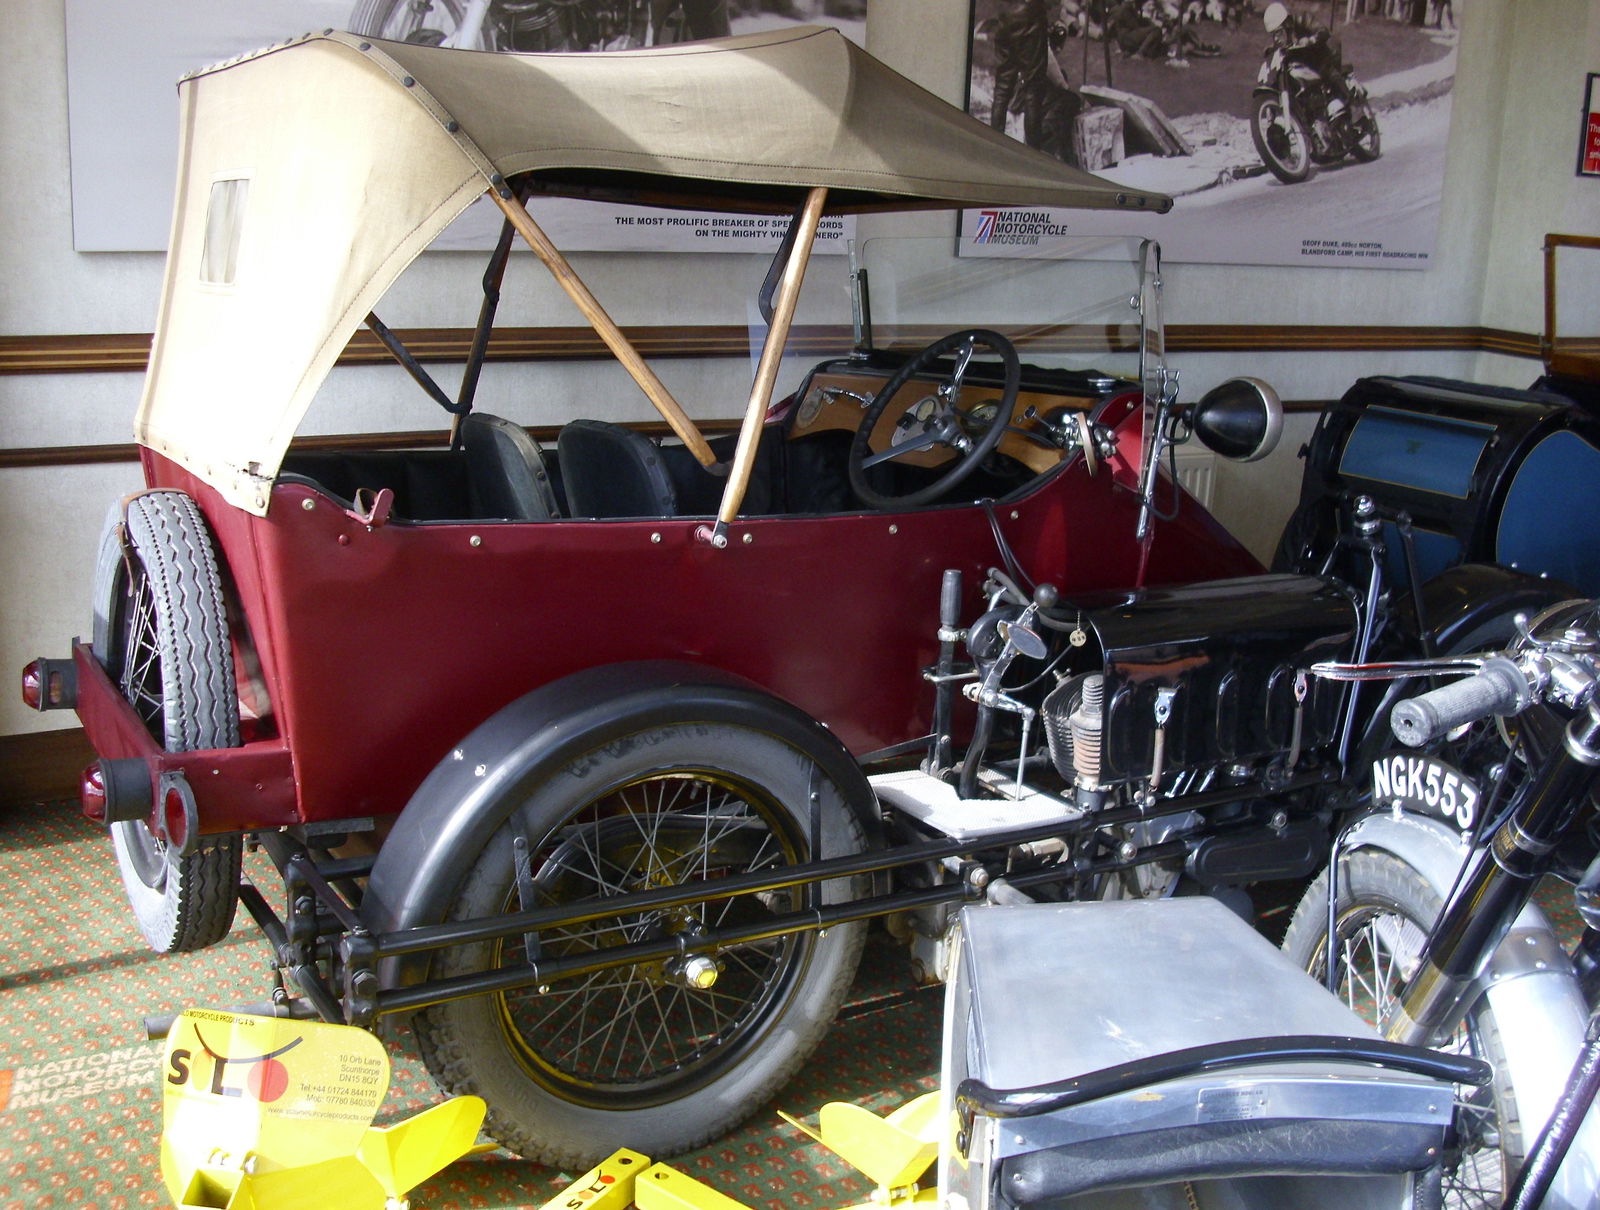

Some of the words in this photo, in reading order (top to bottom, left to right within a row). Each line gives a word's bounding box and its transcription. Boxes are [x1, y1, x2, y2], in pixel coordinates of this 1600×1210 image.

[615, 217, 634, 225] THE
[637, 217, 664, 226] MOST
[667, 218, 709, 226] PROLIFIC
[712, 219, 755, 227] BREAKER
[772, 220, 790, 228] SPE
[818, 221, 843, 229] ORDS
[998, 211, 1051, 224] NATIONAL
[695, 229, 709, 237] ON
[732, 230, 768, 238] MIGHTY
[815, 232, 843, 240] NERO"
[995, 223, 1068, 236] MOTORCYCLE
[991, 234, 1040, 246] MUSEUM
[1373, 755, 1476, 829] NGK553
[340, 1054, 348, 1062] 10
[349, 1055, 363, 1064] Orb
[364, 1057, 381, 1066] Lane
[341, 1064, 380, 1076] Scunthorpe
[339, 1073, 360, 1083] DN15
[9, 1070, 155, 1111] MUSEUM
